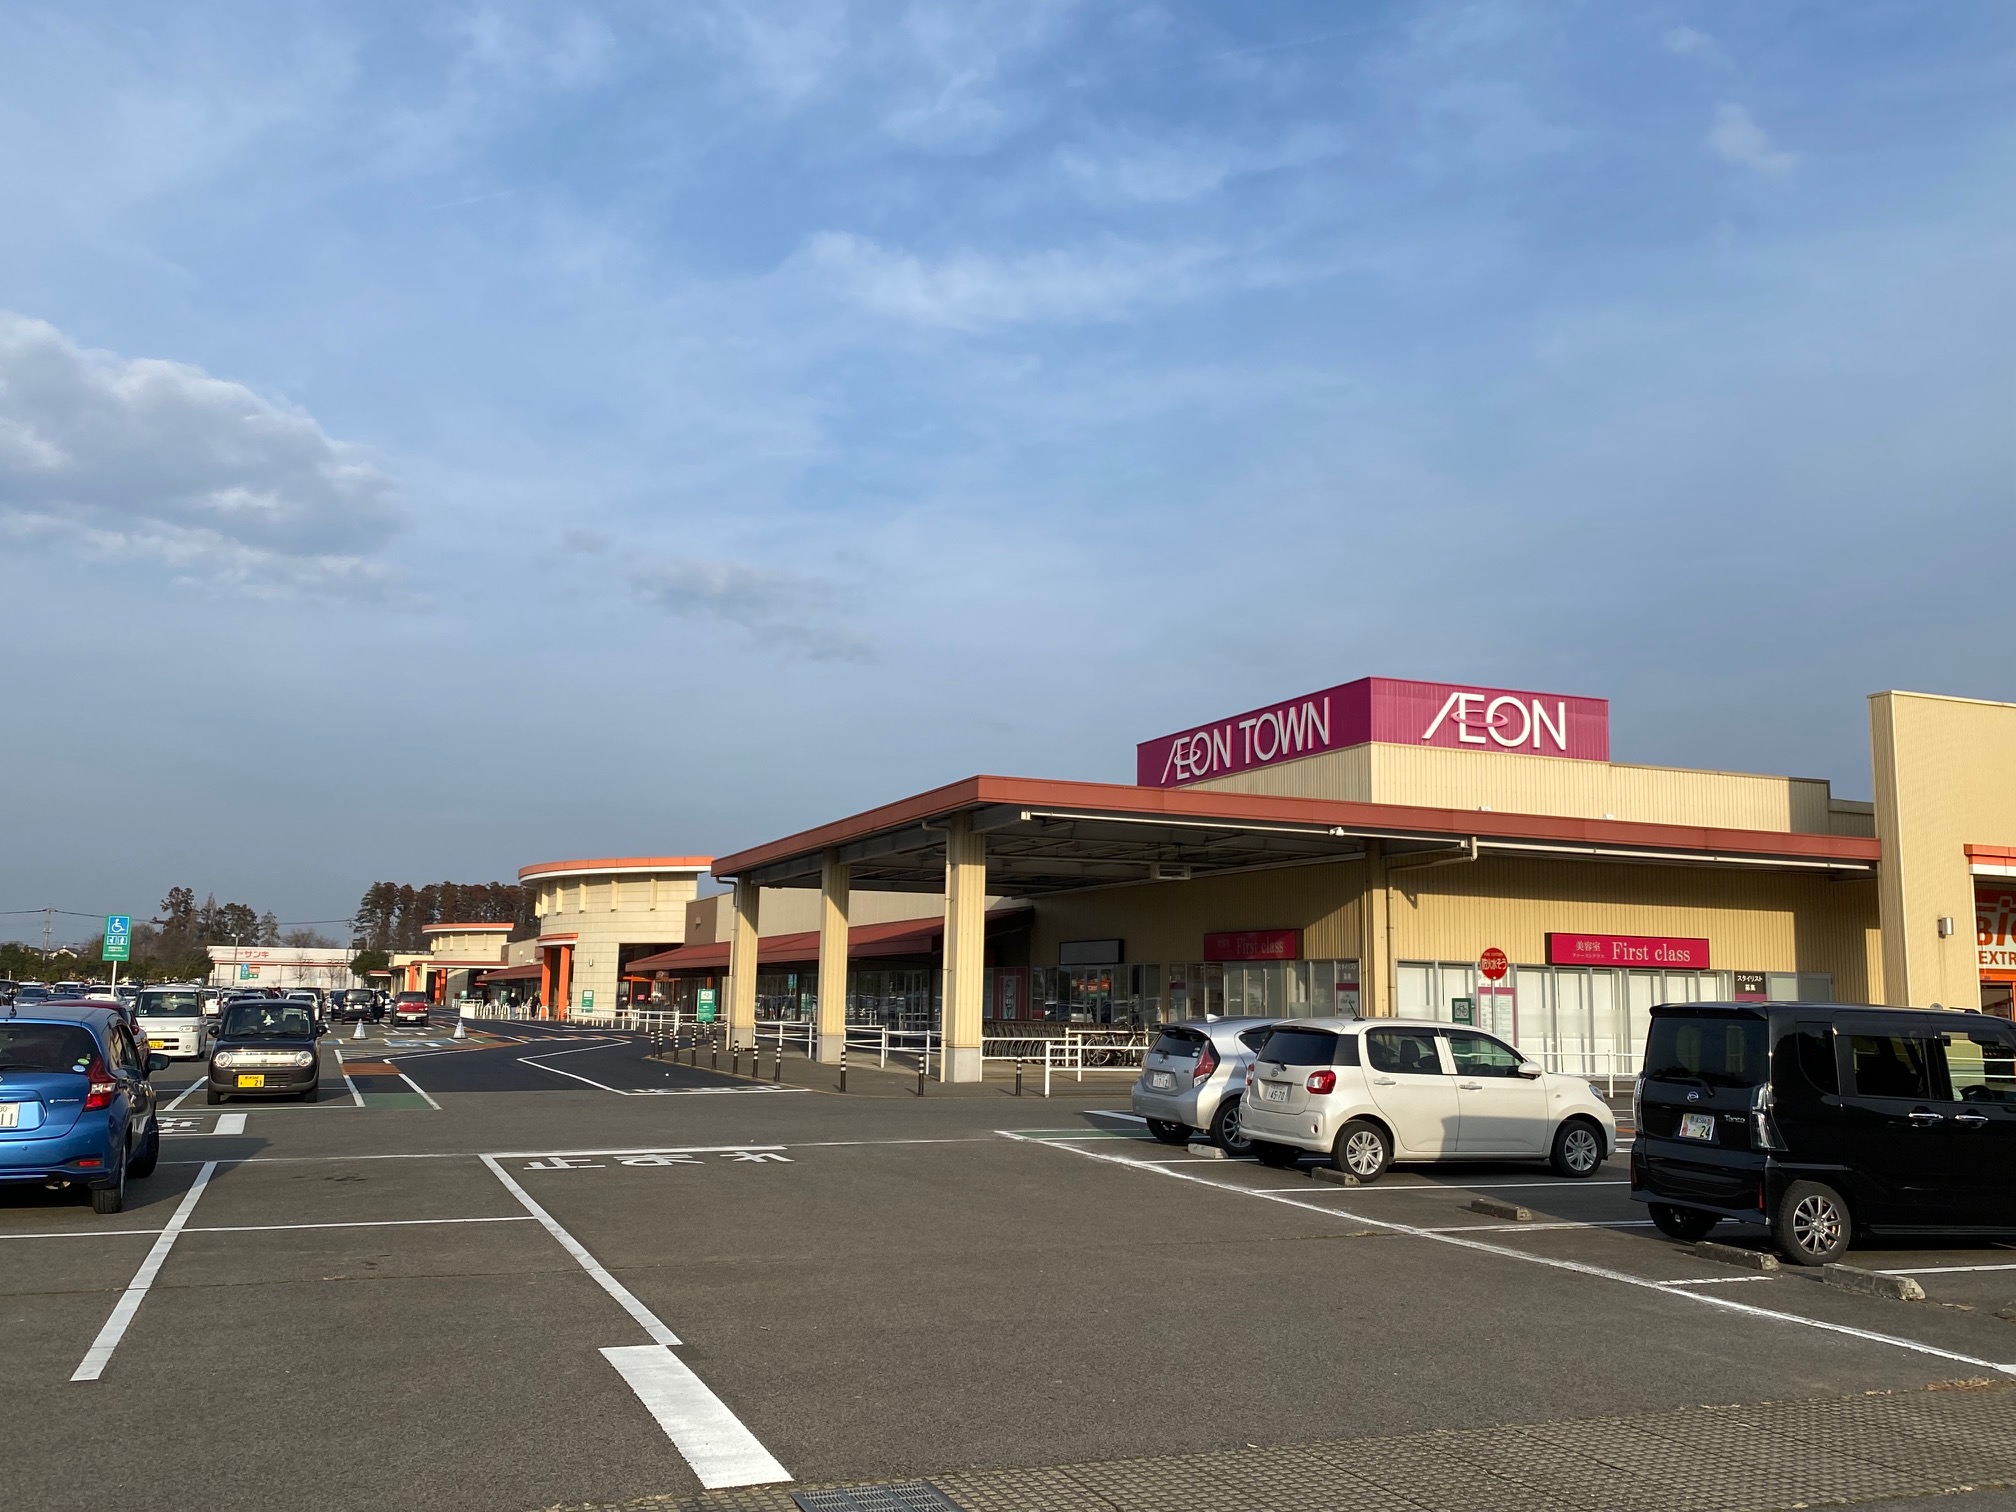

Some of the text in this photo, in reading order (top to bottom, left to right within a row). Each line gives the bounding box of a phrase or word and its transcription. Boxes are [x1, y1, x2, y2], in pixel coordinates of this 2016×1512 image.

[1238, 696, 1331, 765] TOWN
[244, 950, 269, 958] サンキ
[1236, 936, 1258, 955] First
[1261, 936, 1284, 954] class
[1576, 940, 1601, 952] 美容室
[1612, 941, 1691, 962] First class
[1737, 974, 1763, 982] スタイリスト
[523, 1151, 795, 1170] 止まれ
